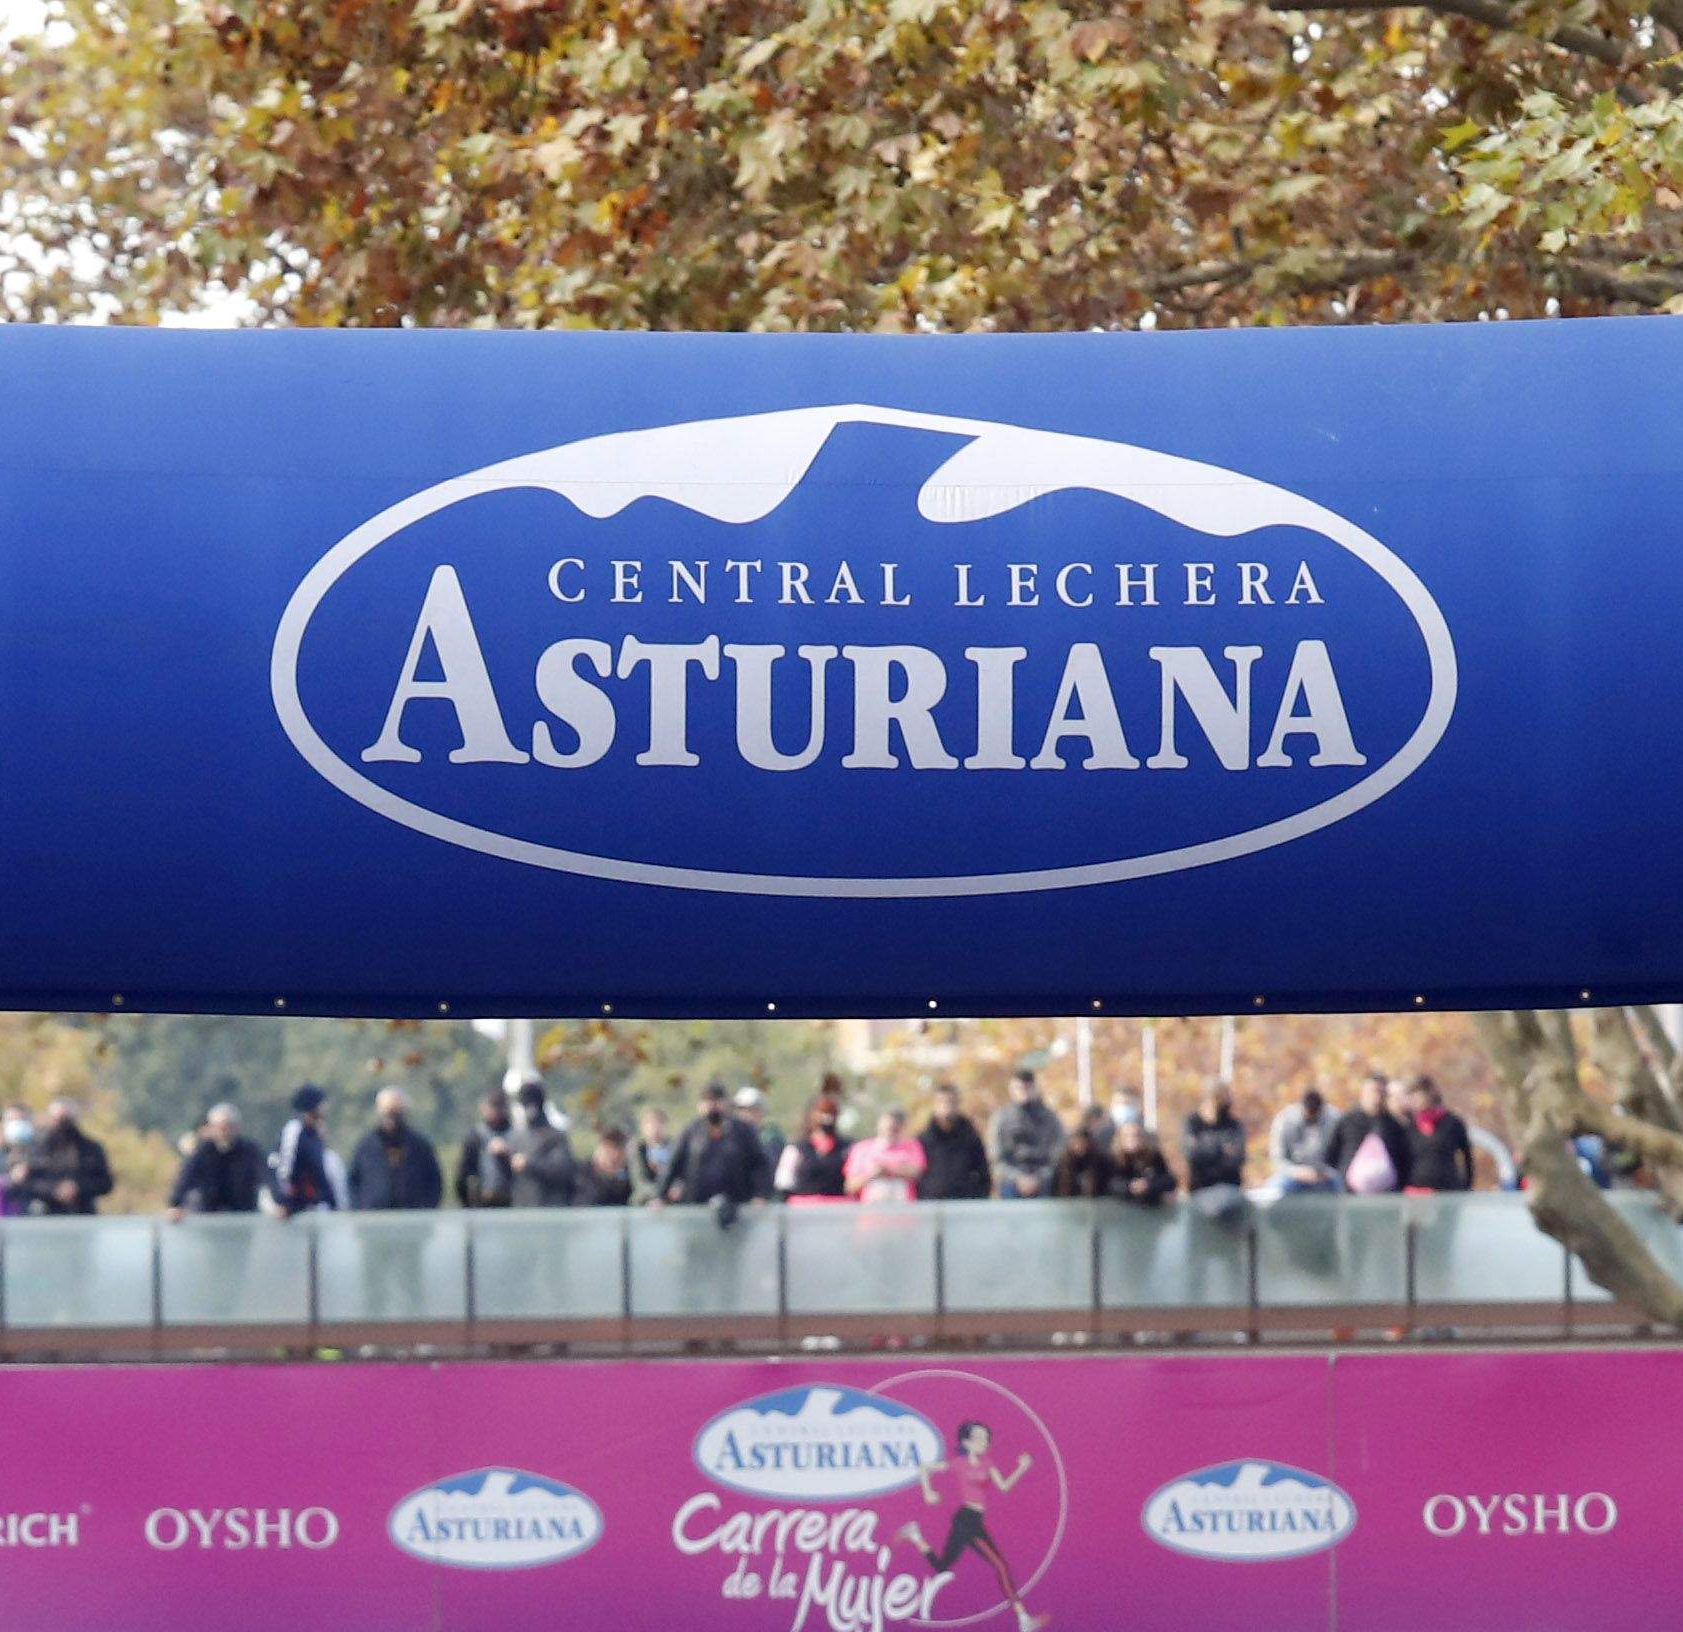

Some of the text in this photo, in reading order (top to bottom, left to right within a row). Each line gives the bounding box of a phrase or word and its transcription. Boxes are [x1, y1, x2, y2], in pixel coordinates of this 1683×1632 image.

[548, 558, 1325, 607] CENTRAL LECHERA
[360, 564, 1366, 771] ASTURIANA
[716, 1429, 922, 1471] ASTURIANA
[144, 1506, 340, 1552] OYSHO
[408, 1507, 586, 1543] ASTURIANA
[672, 1492, 880, 1555] Carrera
[1163, 1500, 1338, 1534] ASTURIANA
[1423, 1491, 1618, 1537] OYSHO
[721, 1554, 764, 1600] de
[768, 1554, 799, 1600] la
